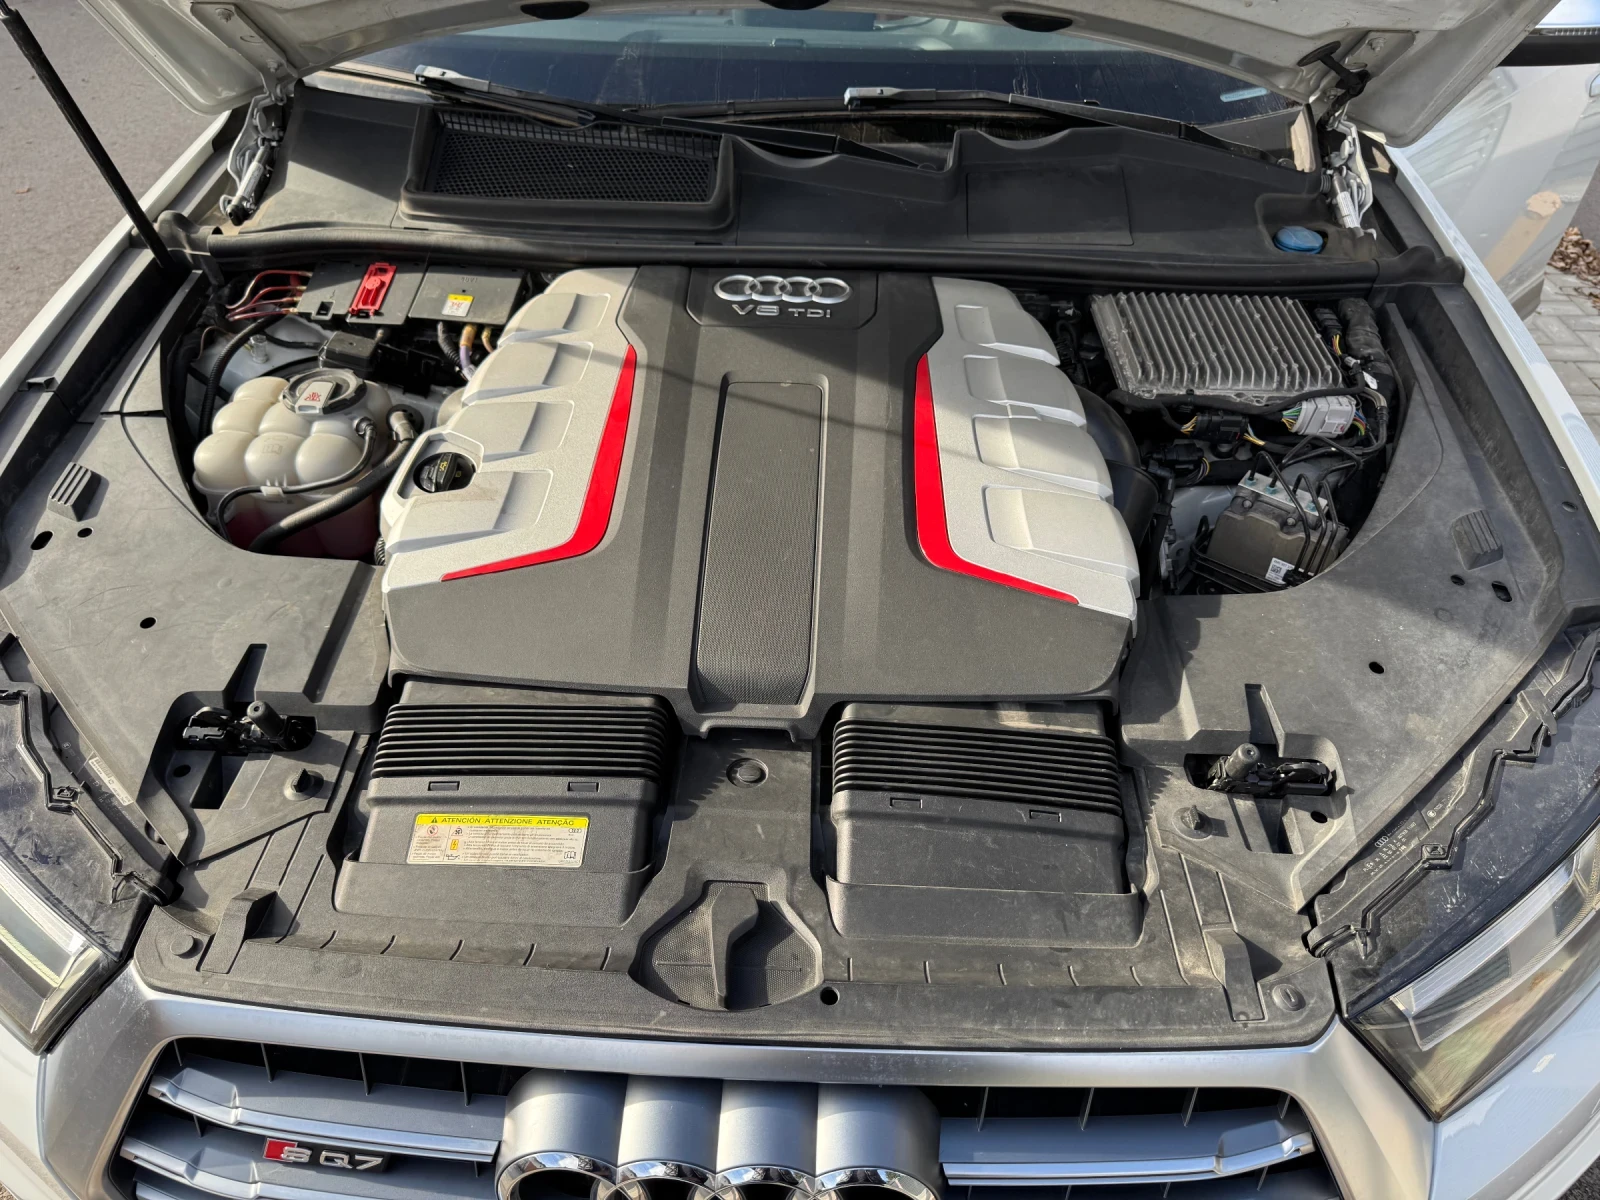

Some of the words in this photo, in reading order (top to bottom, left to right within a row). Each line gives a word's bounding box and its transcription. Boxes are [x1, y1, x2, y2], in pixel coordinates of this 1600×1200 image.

[731, 304, 780, 316] V8
[788, 308, 831, 318] TDI
[536, 818, 575, 826] ATENÇÃO
